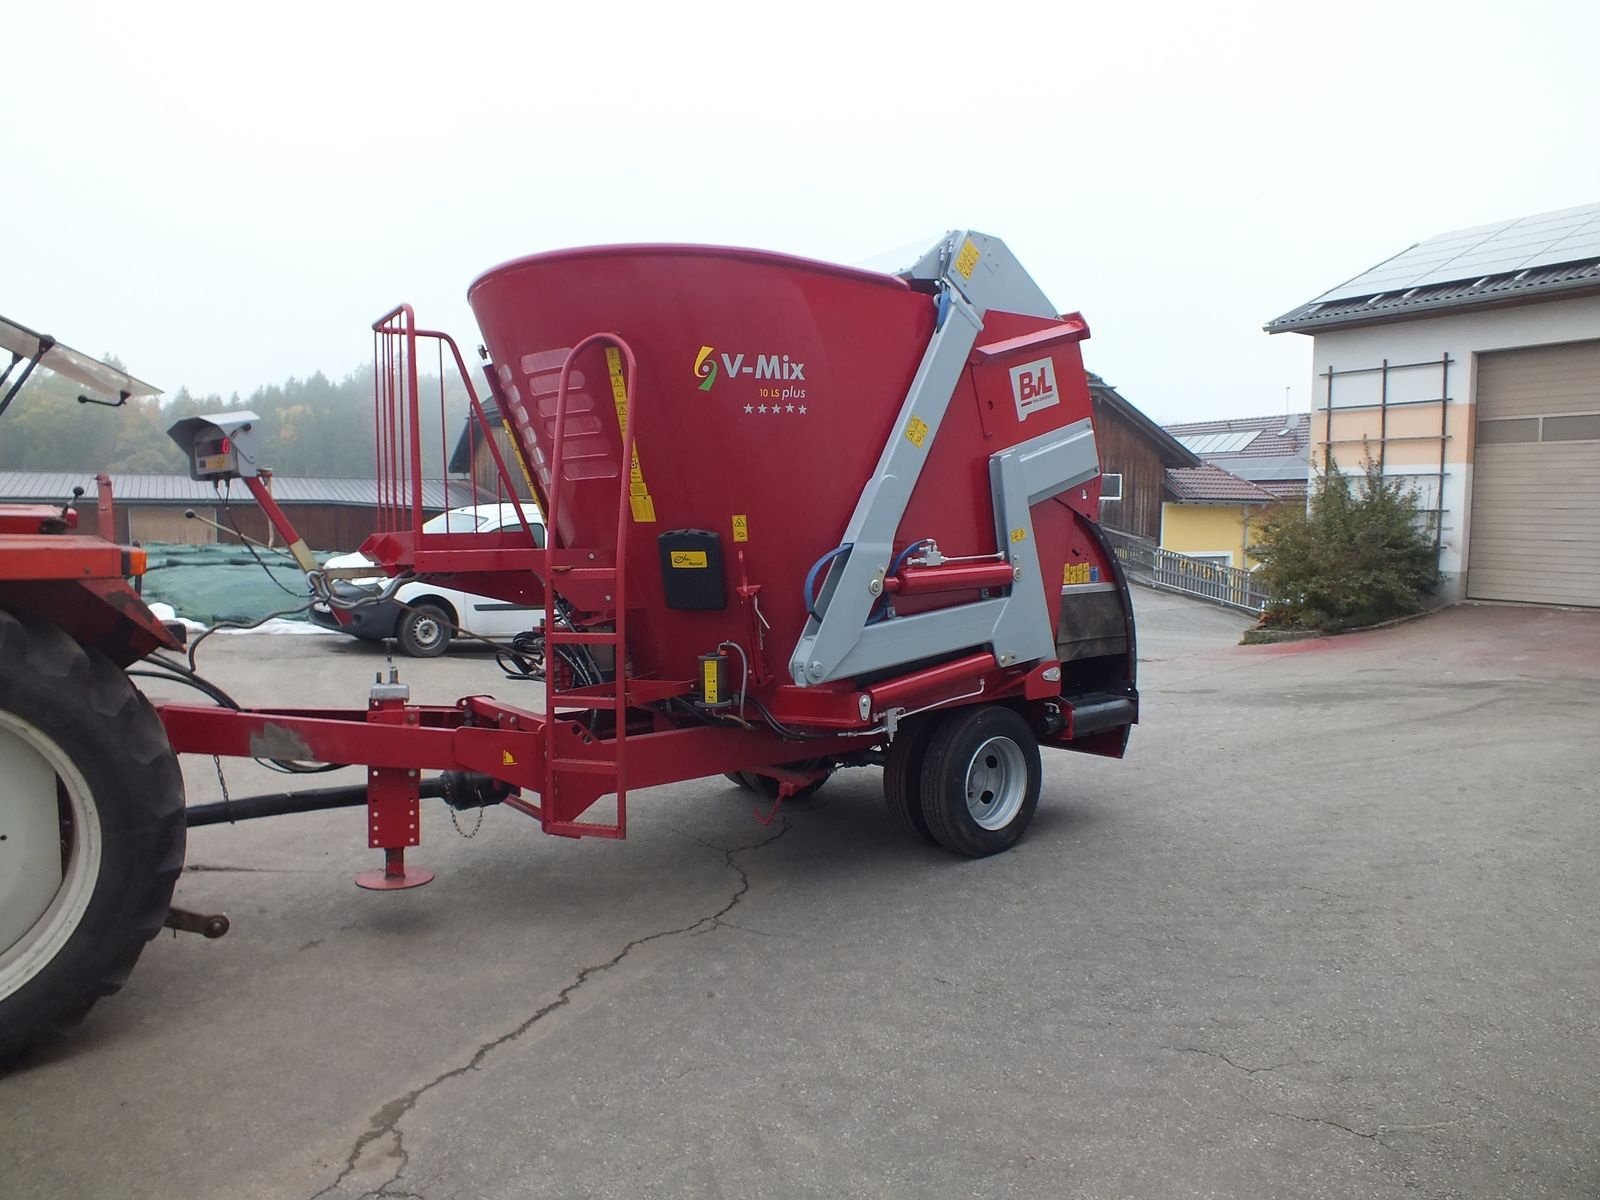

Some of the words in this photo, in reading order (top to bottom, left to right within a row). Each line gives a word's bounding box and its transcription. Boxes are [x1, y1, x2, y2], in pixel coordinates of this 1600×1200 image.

[721, 353, 805, 380] V-Mix
[759, 388, 768, 398] 10
[771, 388, 780, 398] LS
[781, 385, 806, 400] plus
